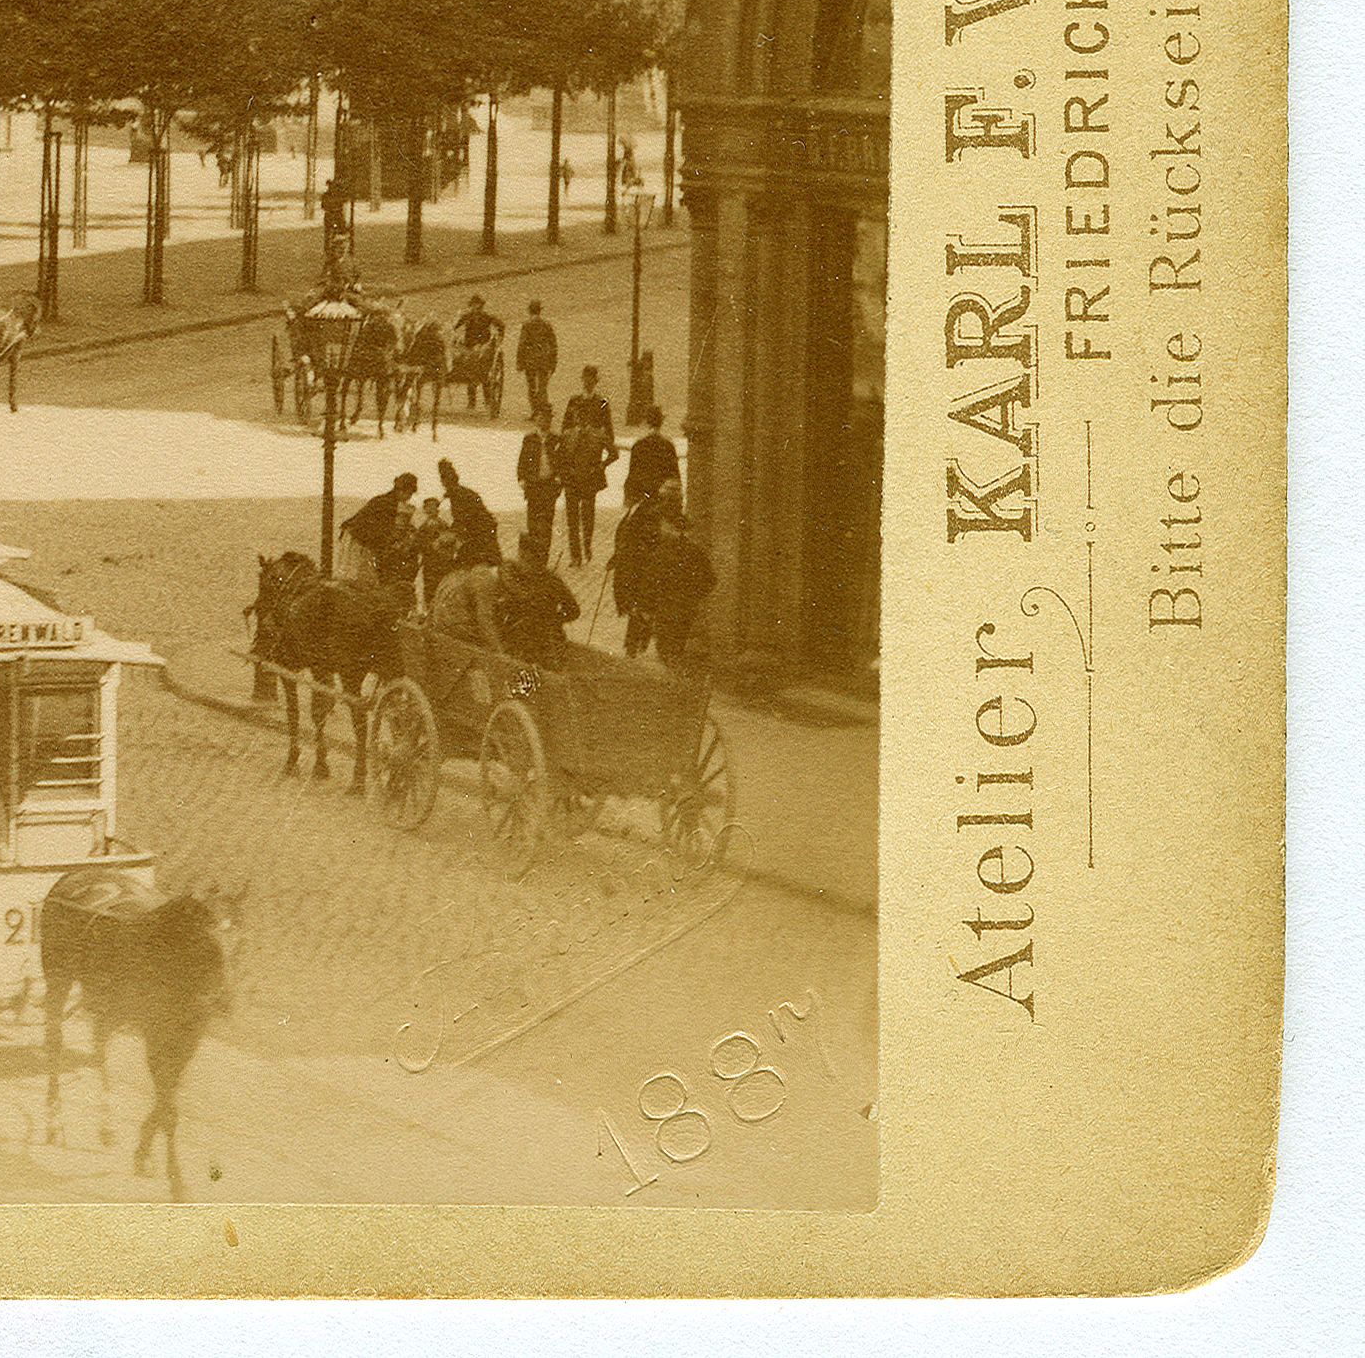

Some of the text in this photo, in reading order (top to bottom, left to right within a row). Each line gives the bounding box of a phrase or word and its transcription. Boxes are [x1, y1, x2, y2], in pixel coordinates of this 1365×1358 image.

[943, 68, 1040, 163] F.
[943, 205, 1040, 544] KARL
[1150, 333, 1203, 431] die
[1148, 472, 1203, 633] Bitte
[955, 620, 1037, 1023] Atelier
